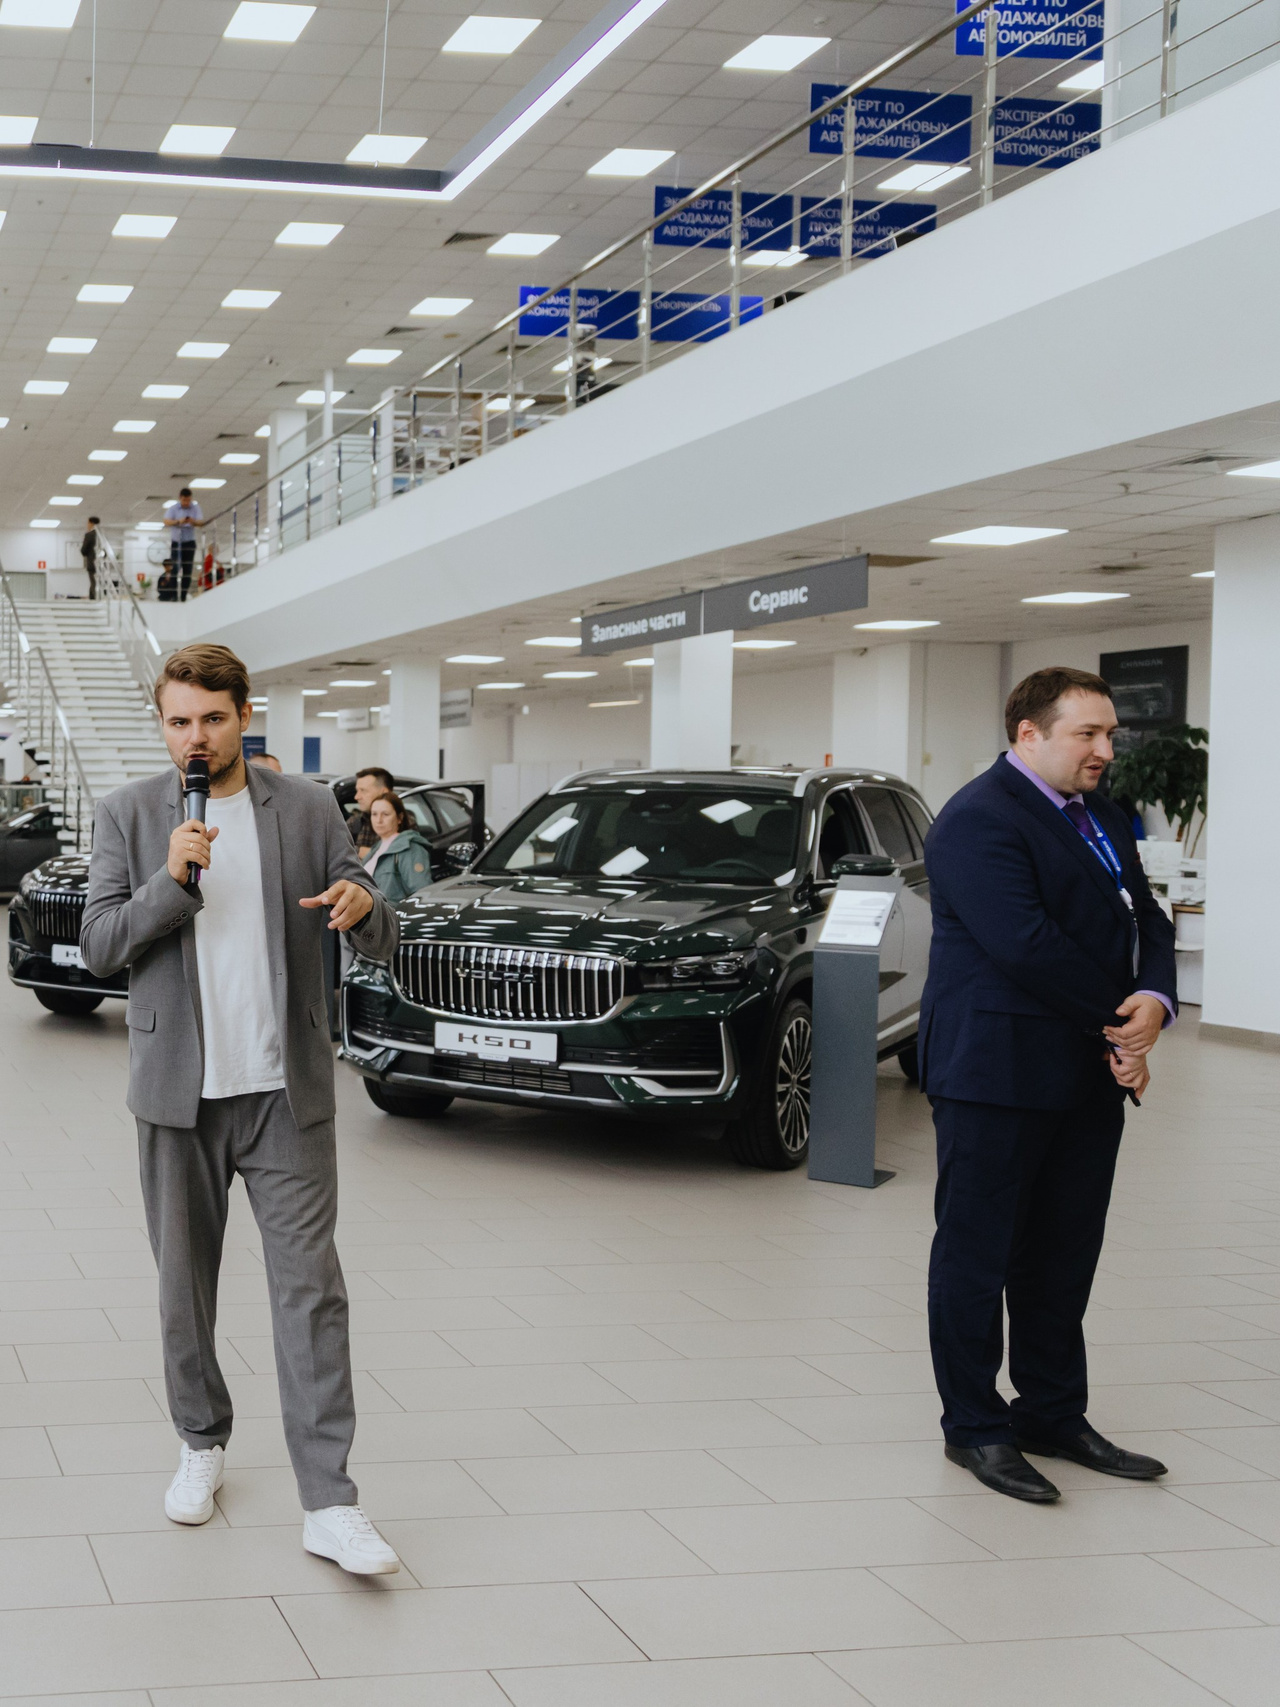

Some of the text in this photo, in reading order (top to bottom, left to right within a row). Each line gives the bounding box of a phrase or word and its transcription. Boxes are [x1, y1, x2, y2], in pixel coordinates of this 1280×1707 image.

[1064, 13, 1105, 28] НОВ
[968, 28, 1087, 47] АВОМОБИЛЕЙ
[822, 96, 905, 114] ПЕРТ ПО
[821, 113, 898, 131] ПРОАЖАМ
[1056, 113, 1075, 126] ПО
[820, 130, 921, 149] АВТМОБИЛЕЙ
[663, 196, 716, 210] ЭКЕРТ
[669, 211, 774, 228] РОДАЖАМ ОВЫХ
[810, 208, 860, 220] ЭКСПТ
[662, 224, 749, 240] АВТОМОБИЛЙ
[655, 300, 721, 313] ОФОРМИЕЛЬ
[748, 586, 809, 614] Сервис
[591, 610, 686, 643] Запасные части
[458, 1032, 531, 1050] K50
